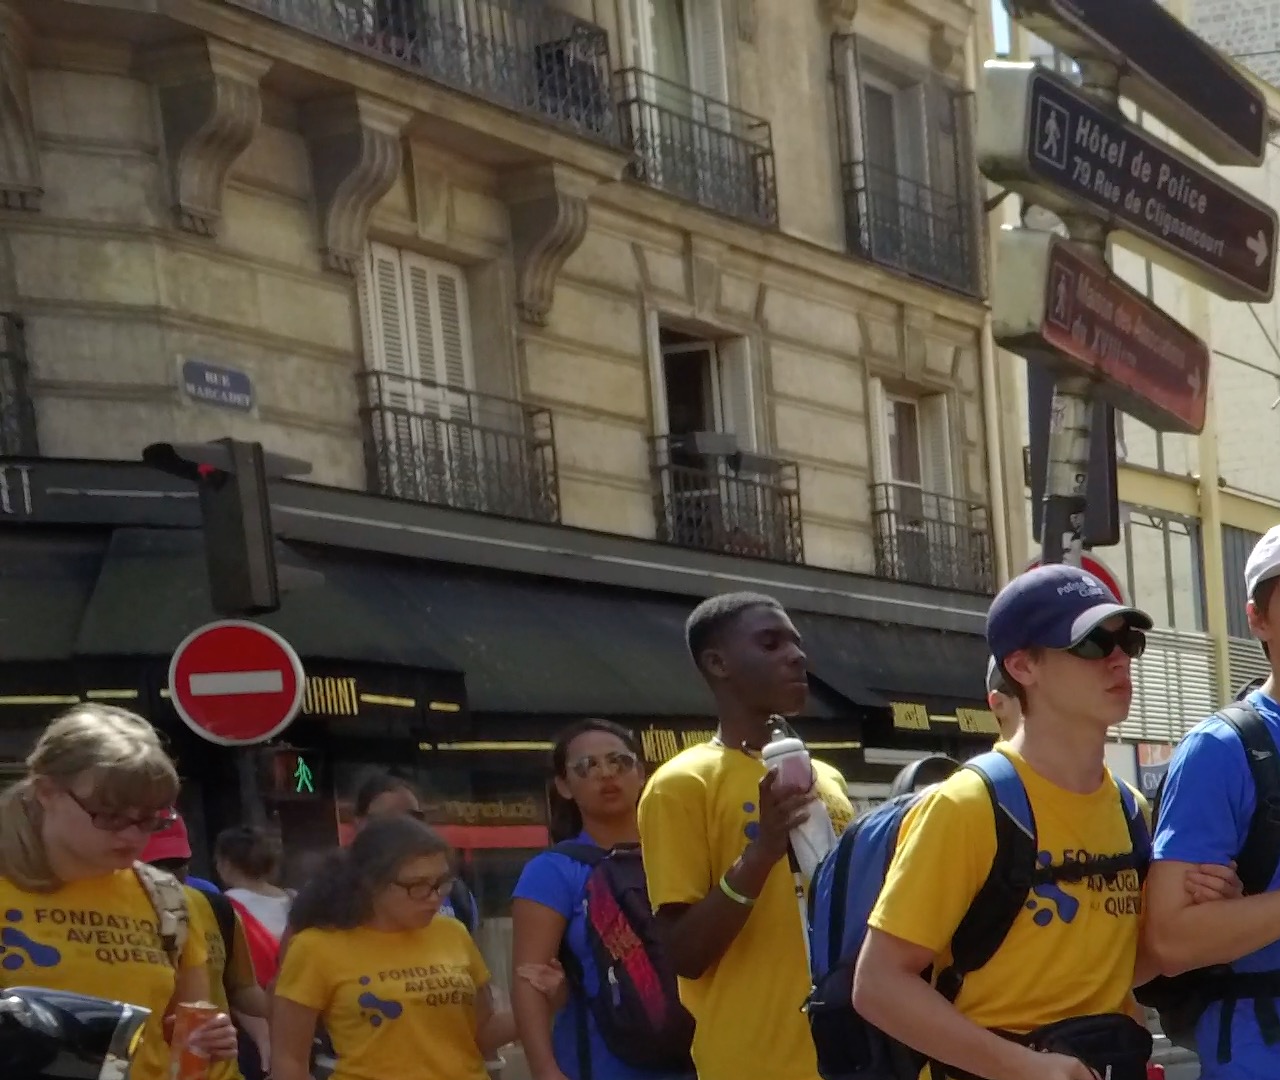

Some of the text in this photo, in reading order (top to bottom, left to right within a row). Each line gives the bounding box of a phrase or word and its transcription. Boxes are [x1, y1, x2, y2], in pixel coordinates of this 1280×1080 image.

[1075, 115, 1207, 214] Hôtel de Police
[1094, 169, 1121, 203] Rue
